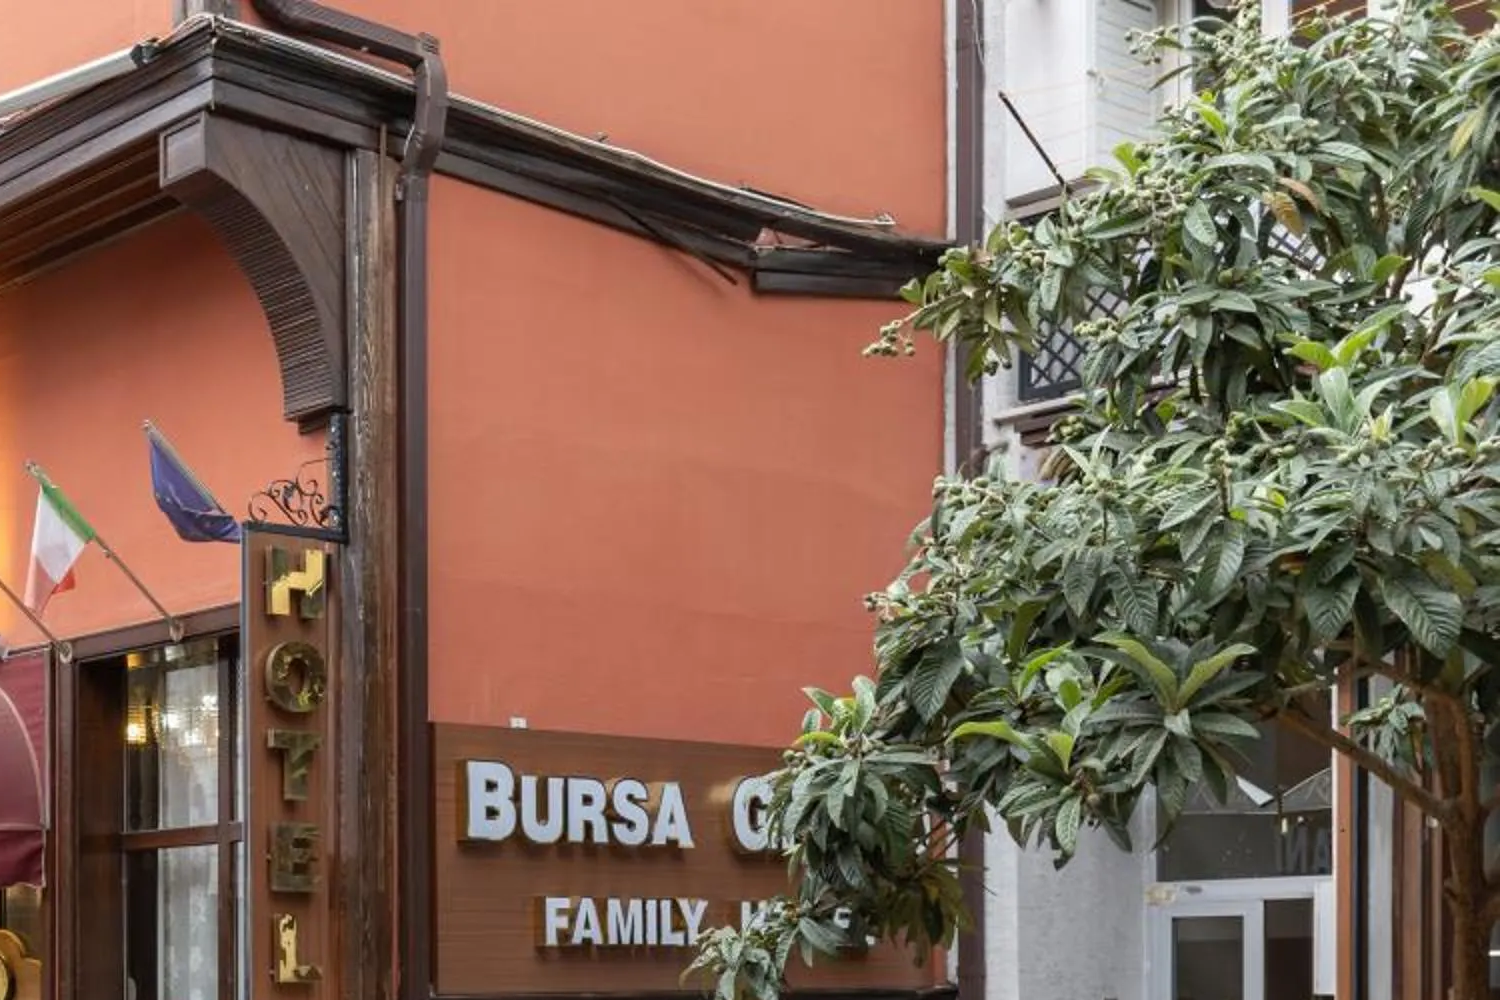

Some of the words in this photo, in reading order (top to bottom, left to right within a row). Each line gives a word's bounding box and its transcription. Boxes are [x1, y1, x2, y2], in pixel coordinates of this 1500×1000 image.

[264, 545, 327, 984] HOTEL
[466, 760, 694, 849] BURSA
[545, 897, 707, 946] FAMILY
